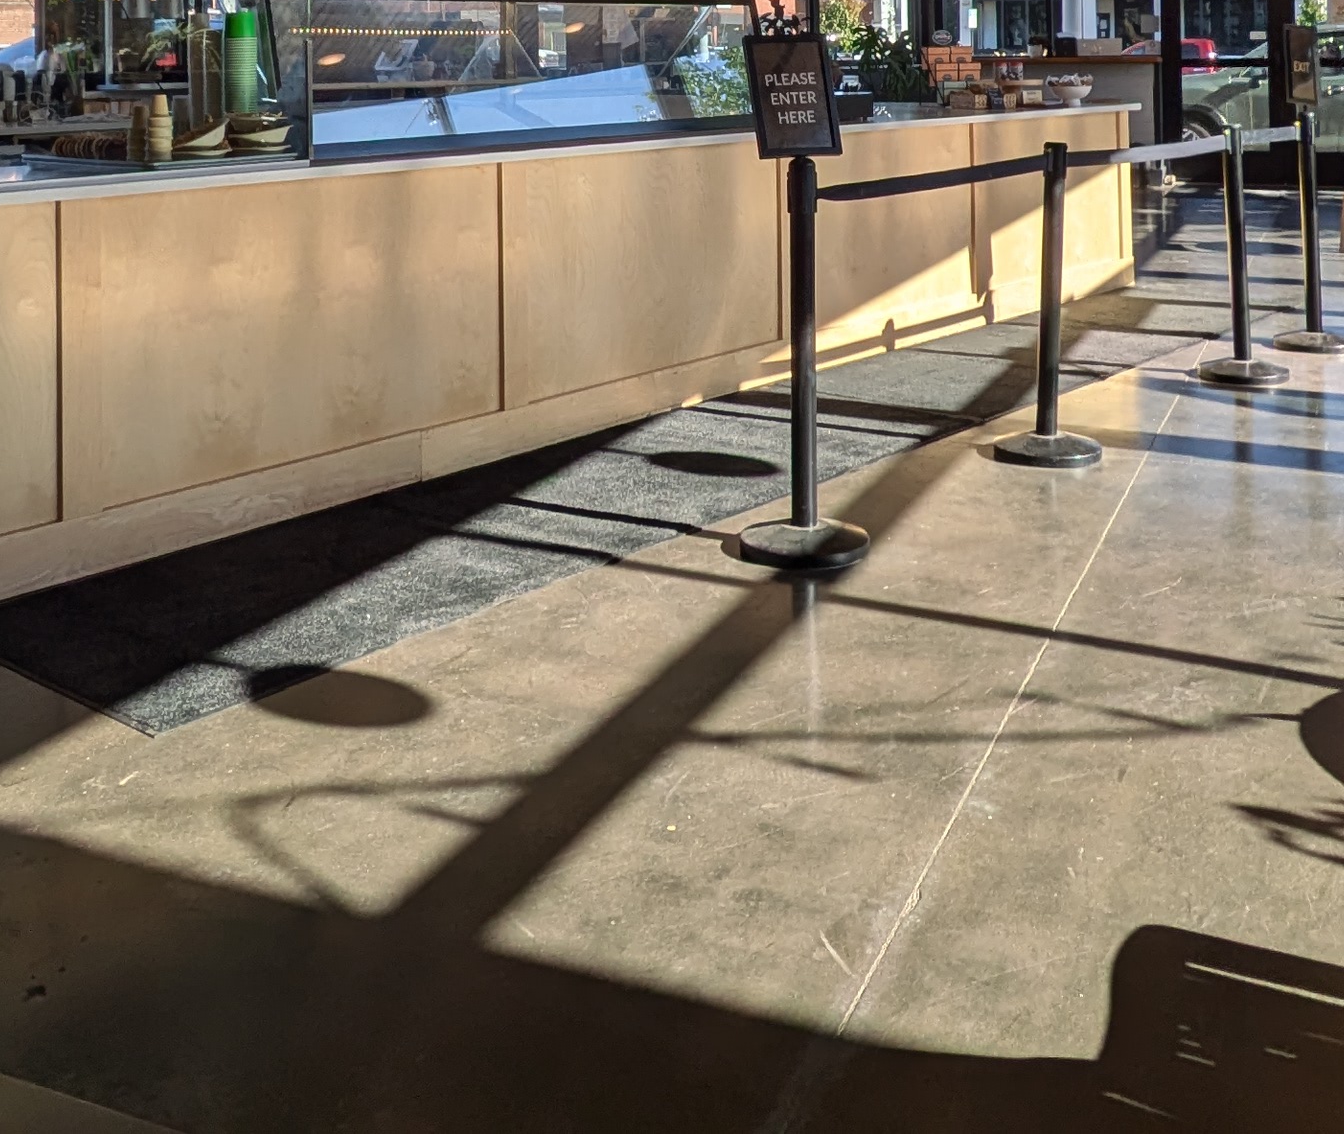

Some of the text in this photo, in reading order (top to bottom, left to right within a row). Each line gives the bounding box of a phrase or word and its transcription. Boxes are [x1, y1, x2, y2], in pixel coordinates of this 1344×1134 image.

[1294, 60, 1310, 72] EXIT
[765, 72, 816, 87] PLEASE
[771, 91, 817, 106] ENTER
[778, 110, 816, 124] HERE
